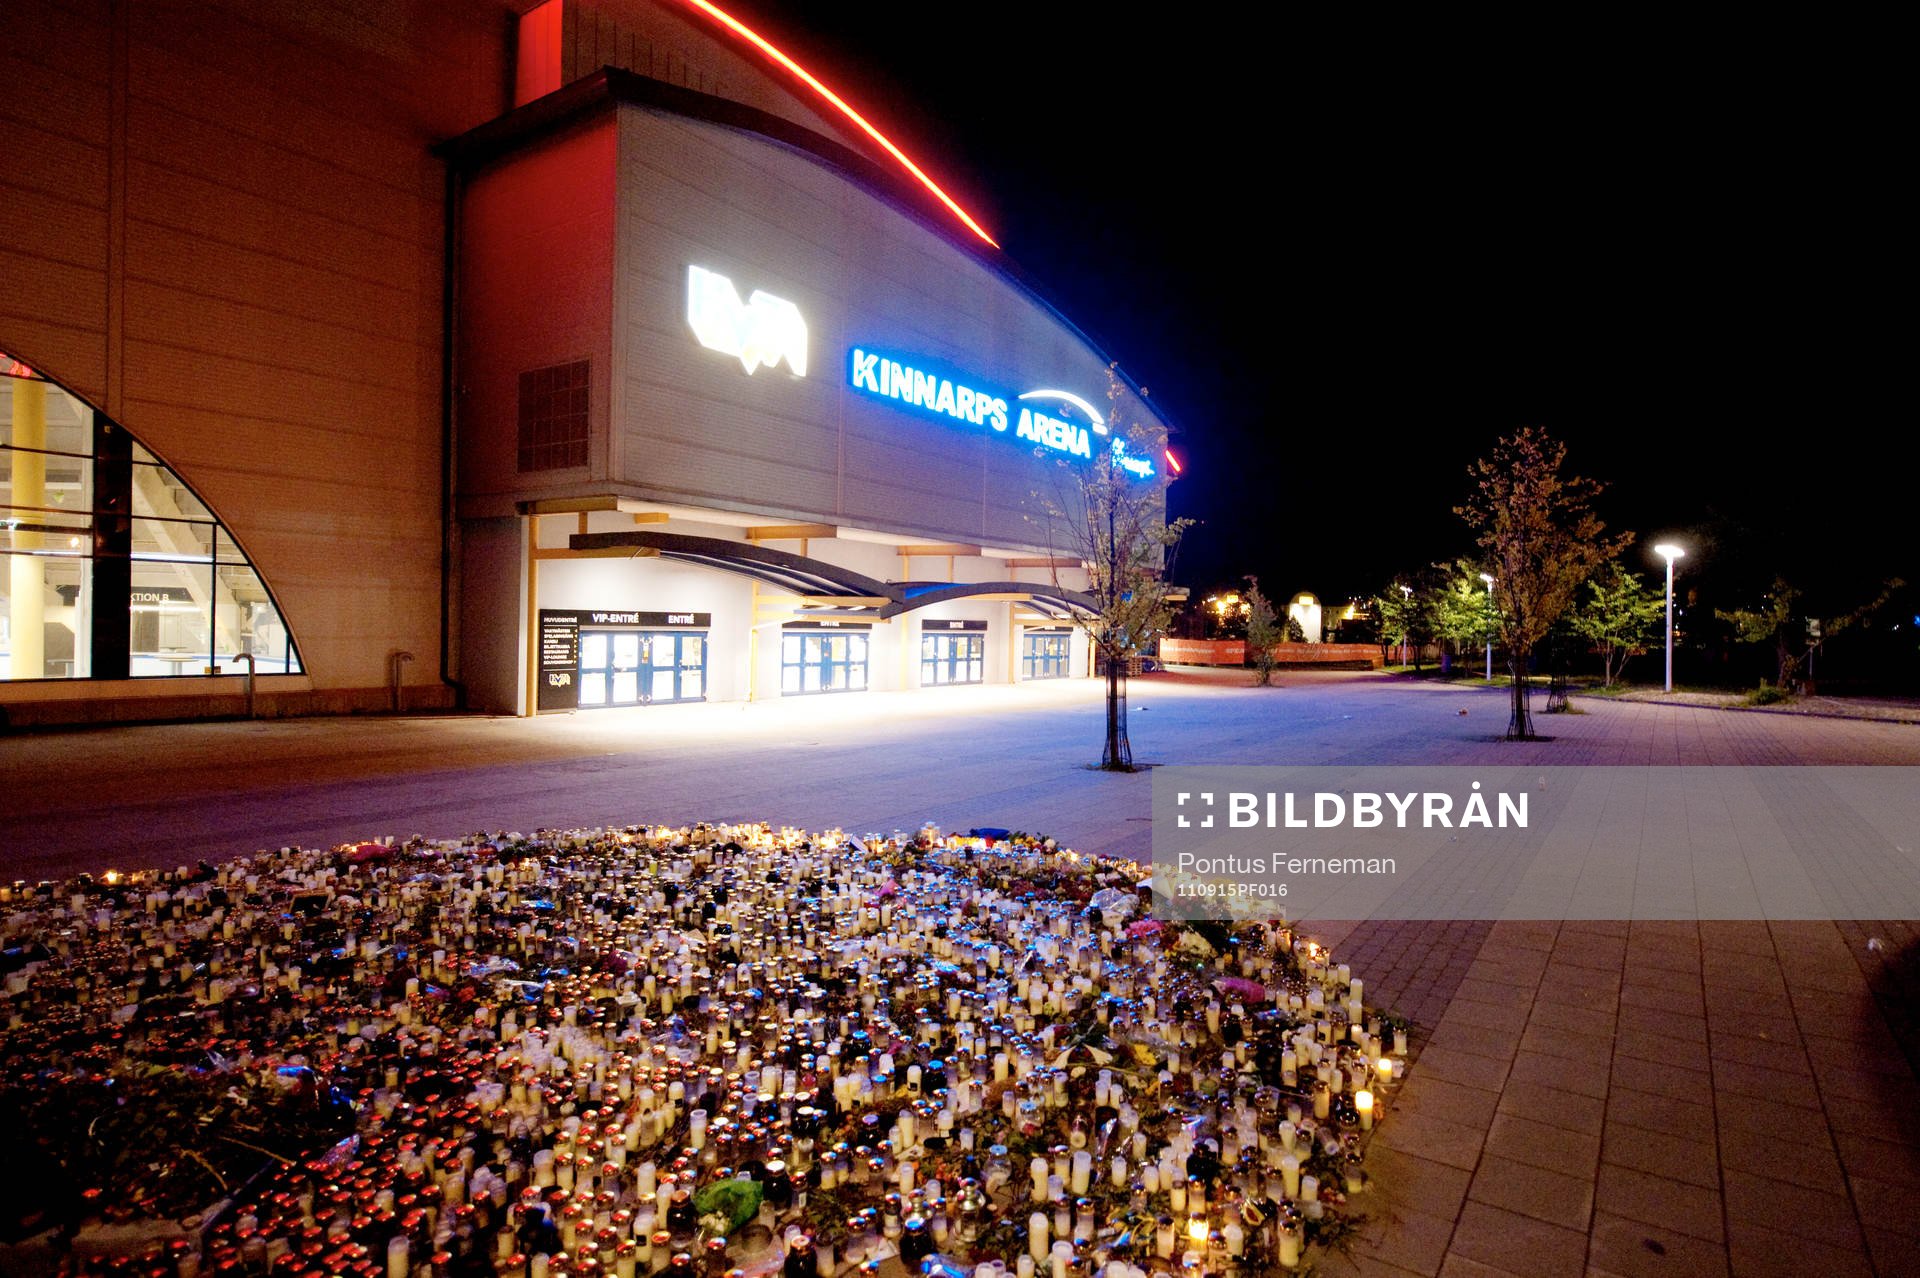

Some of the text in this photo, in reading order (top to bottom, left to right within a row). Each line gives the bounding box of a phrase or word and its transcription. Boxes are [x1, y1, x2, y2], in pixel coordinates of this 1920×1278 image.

[853, 348, 1008, 432] KINNARPS
[1016, 408, 1091, 458] ARENA
[592, 612, 639, 624] VIP-ENTRÉ
[668, 613, 695, 625] ENTRÉ
